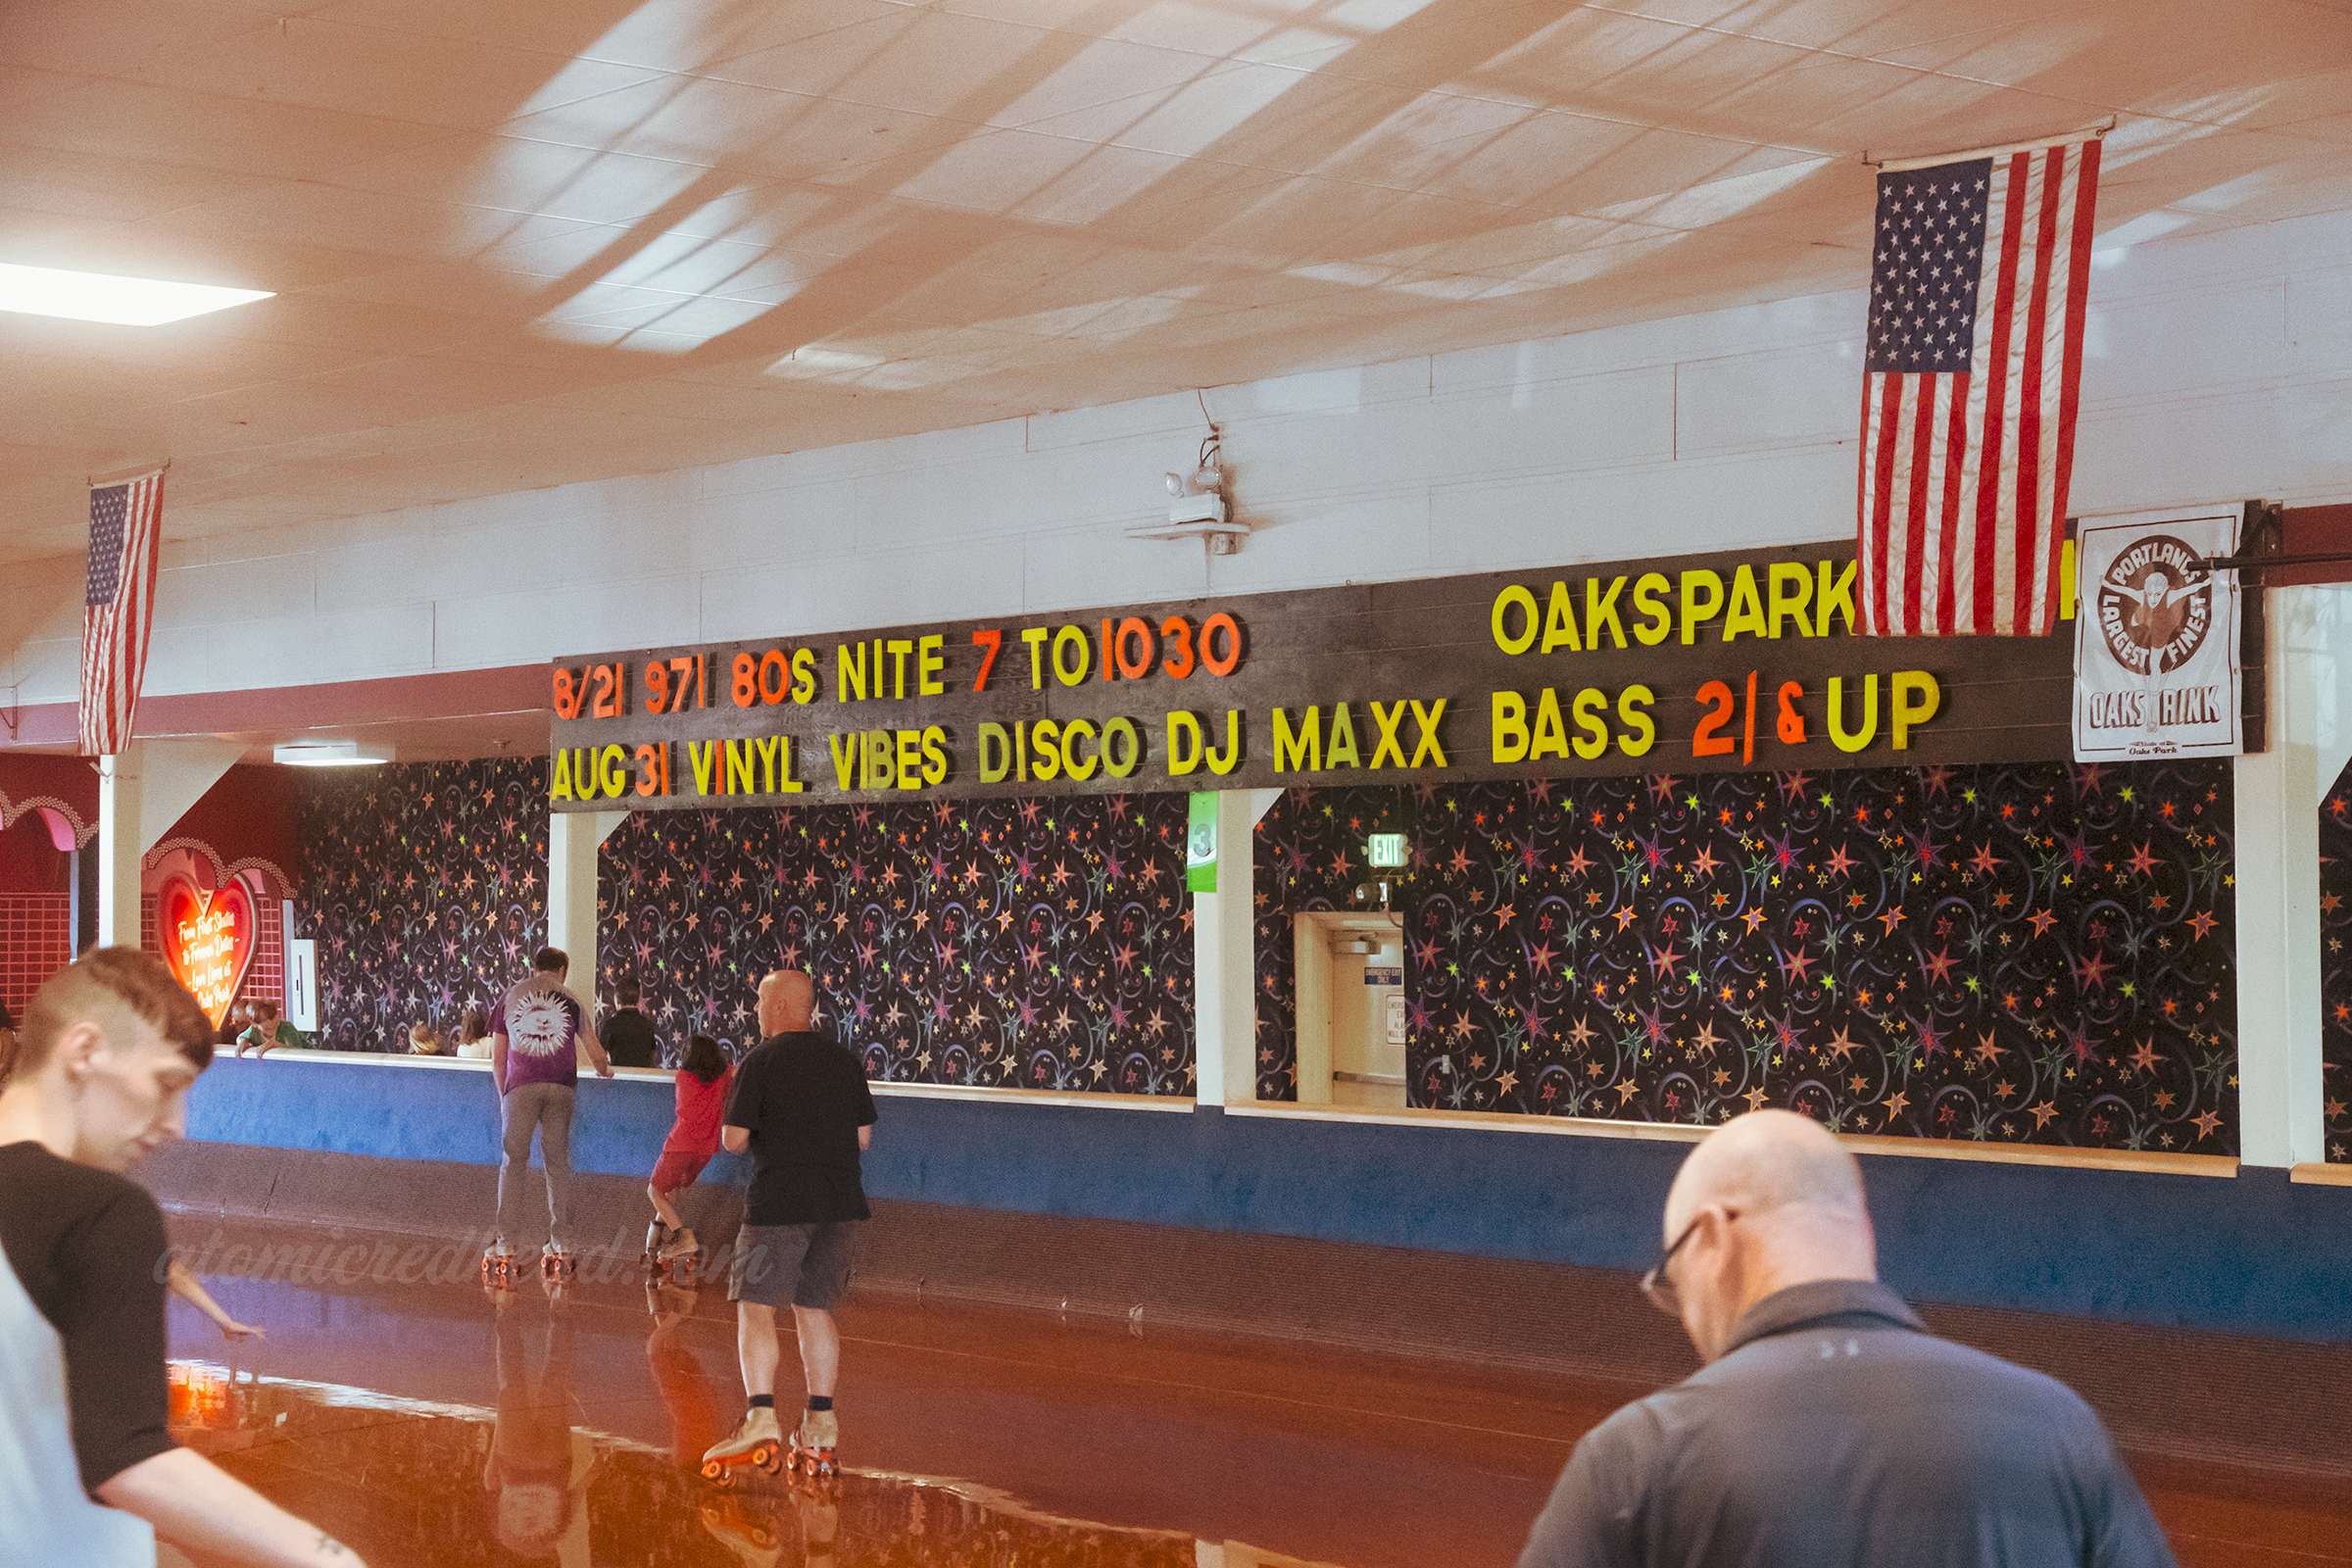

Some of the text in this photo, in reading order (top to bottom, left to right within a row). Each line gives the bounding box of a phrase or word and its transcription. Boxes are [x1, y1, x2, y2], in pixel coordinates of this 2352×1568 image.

[2102, 594, 2150, 669] LARGEST
[2168, 594, 2207, 664] FINEST
[553, 662, 623, 719] 8/21
[645, 654, 705, 714] 971
[731, 648, 815, 708] 80S
[838, 634, 945, 703] NITE
[972, 629, 1002, 692] 7
[1021, 624, 1090, 689] TO
[2090, 685, 2222, 728] OAKS RINK
[551, 744, 626, 802] AUG
[635, 741, 669, 797] 31
[688, 735, 804, 796] VINYL
[829, 725, 948, 791] VIBES
[979, 715, 1139, 783] DISCO
[1166, 710, 1239, 775] DJ
[1273, 699, 1448, 772] MAXX
[1492, 684, 1656, 763] BASS
[1777, 680, 1807, 745] &
[1827, 670, 1940, 753] UP
[1194, 822, 1211, 858] 3
[1373, 835, 1399, 864] EXIT
